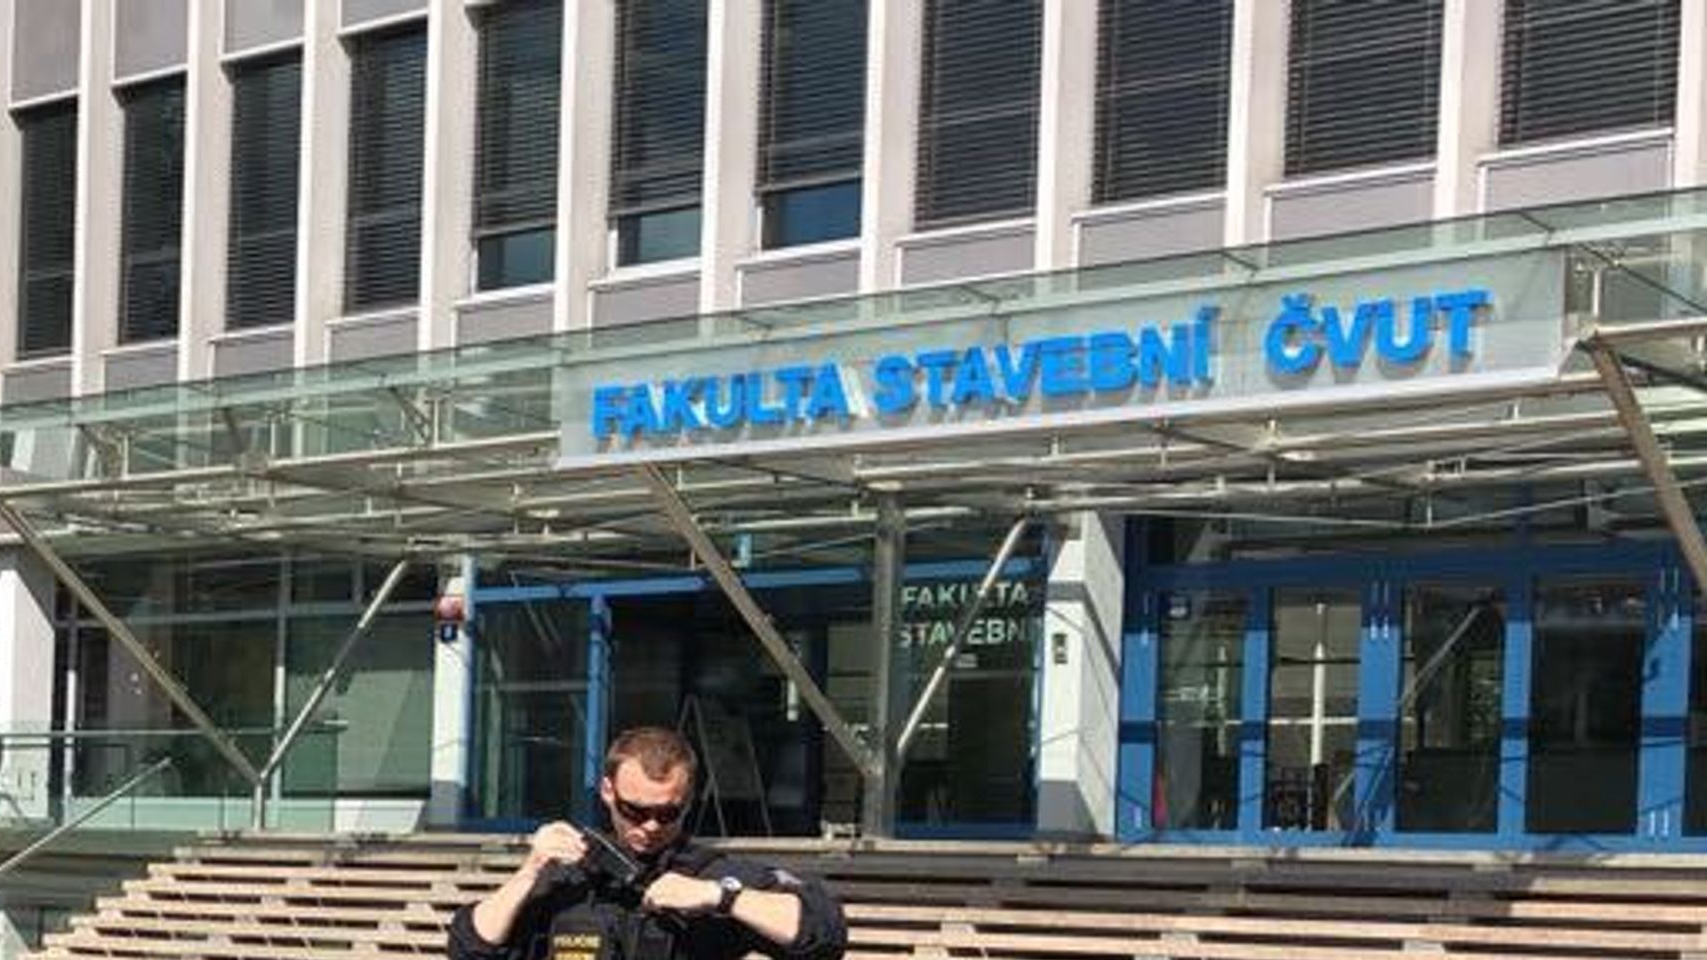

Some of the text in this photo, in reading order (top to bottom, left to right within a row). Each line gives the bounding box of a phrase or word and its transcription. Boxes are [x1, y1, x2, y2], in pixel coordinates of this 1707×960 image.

[592, 289, 1491, 440] FAKULTA STAVEBNÍ ČVUT
